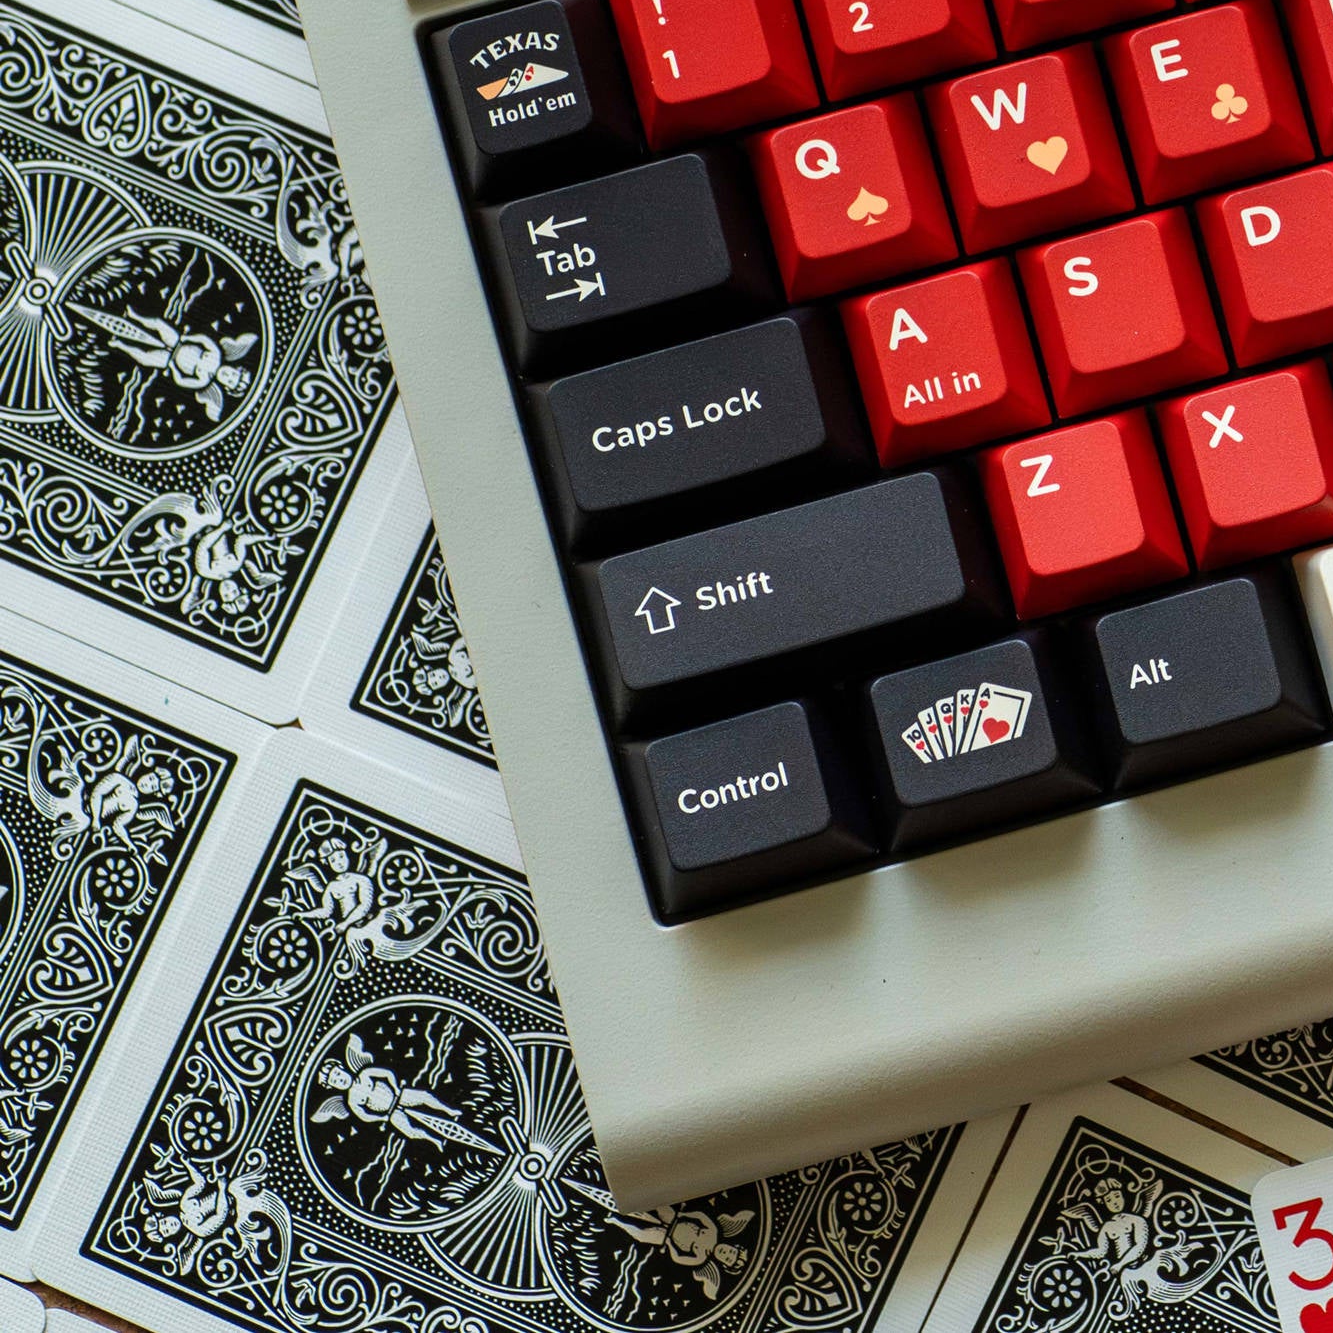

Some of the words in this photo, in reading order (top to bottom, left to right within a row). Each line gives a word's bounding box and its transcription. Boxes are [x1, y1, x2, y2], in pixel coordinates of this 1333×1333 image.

[848, 1, 873, 32] 2
[470, 31, 560, 69] TEXAS
[662, 49, 680, 79] 1
[1150, 39, 1189, 82] E
[970, 82, 1027, 131] W
[794, 139, 840, 179] Q
[1241, 206, 1281, 246] D
[536, 243, 596, 277] Tab
[1063, 256, 1099, 297] S
[889, 308, 928, 351] A
[903, 378, 943, 409] All
[953, 370, 982, 396] in
[592, 415, 673, 454] Caps
[683, 387, 762, 429] Lock
[1202, 405, 1244, 448] X
[1020, 454, 1060, 498] Z
[695, 572, 774, 611] Shift
[980, 687, 991, 699] A
[1129, 658, 1172, 690] Alt
[960, 694, 969, 705] K
[906, 729, 922, 744] 10
[677, 762, 788, 815] Control
